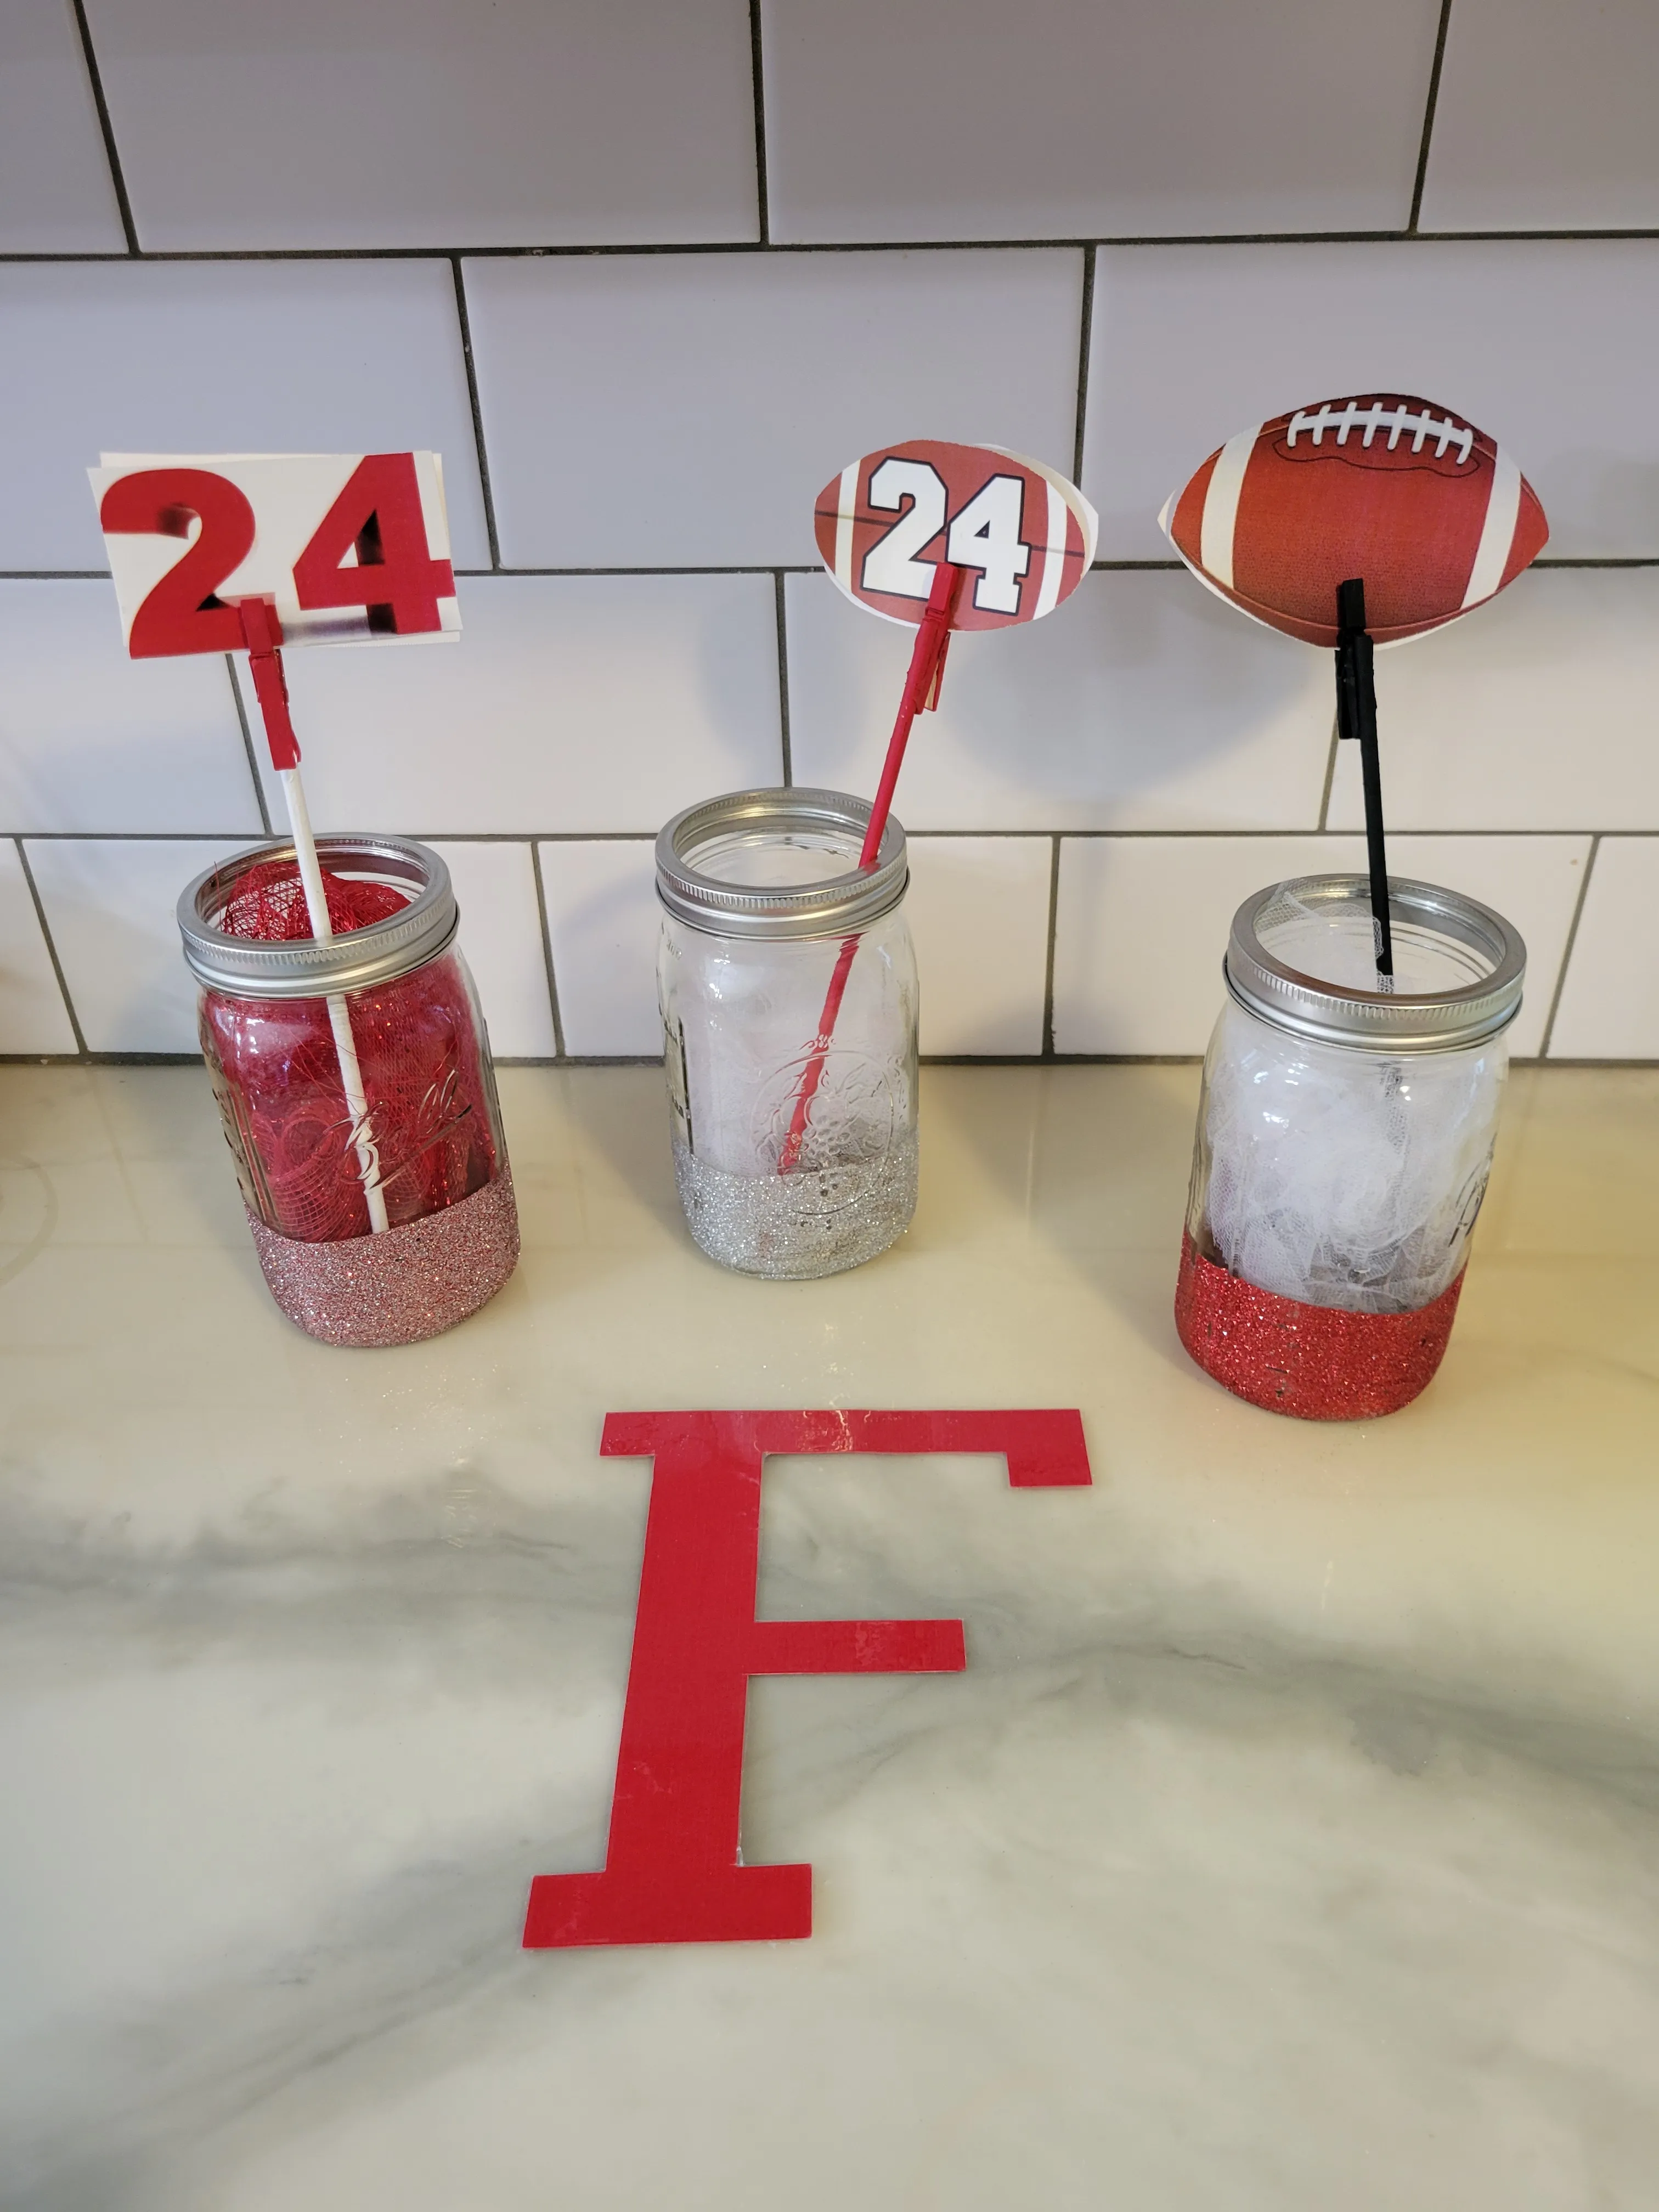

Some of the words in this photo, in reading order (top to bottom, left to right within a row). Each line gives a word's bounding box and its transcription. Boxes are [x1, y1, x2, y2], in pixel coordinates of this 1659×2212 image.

[100, 452, 456, 659] 24
[860, 456, 1032, 616] 24
[522, 1408, 1092, 1948] F
